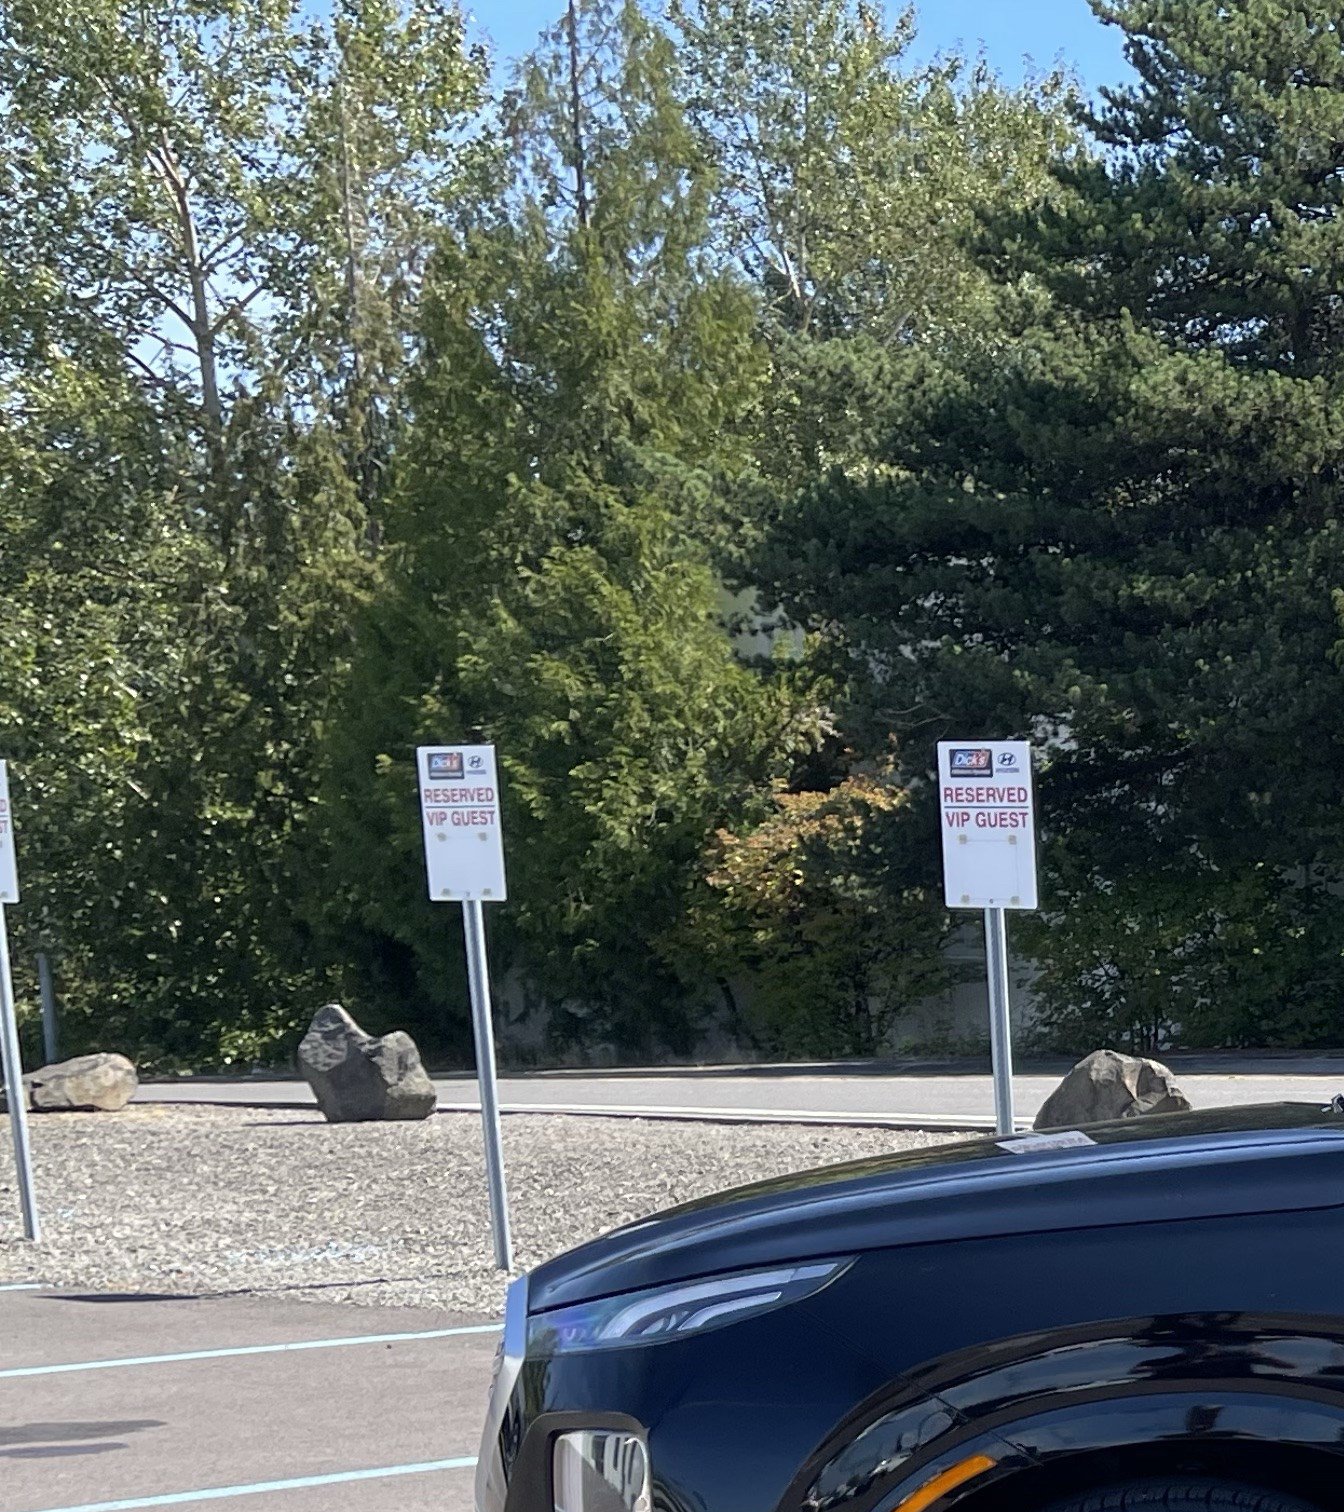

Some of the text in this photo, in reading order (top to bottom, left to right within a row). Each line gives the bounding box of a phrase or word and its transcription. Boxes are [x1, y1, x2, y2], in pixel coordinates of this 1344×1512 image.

[424, 787, 494, 803] RESERVED
[943, 787, 1028, 803] RESERVED
[426, 810, 495, 827] VIP GUEST
[945, 811, 1029, 828] VIP GUEST
